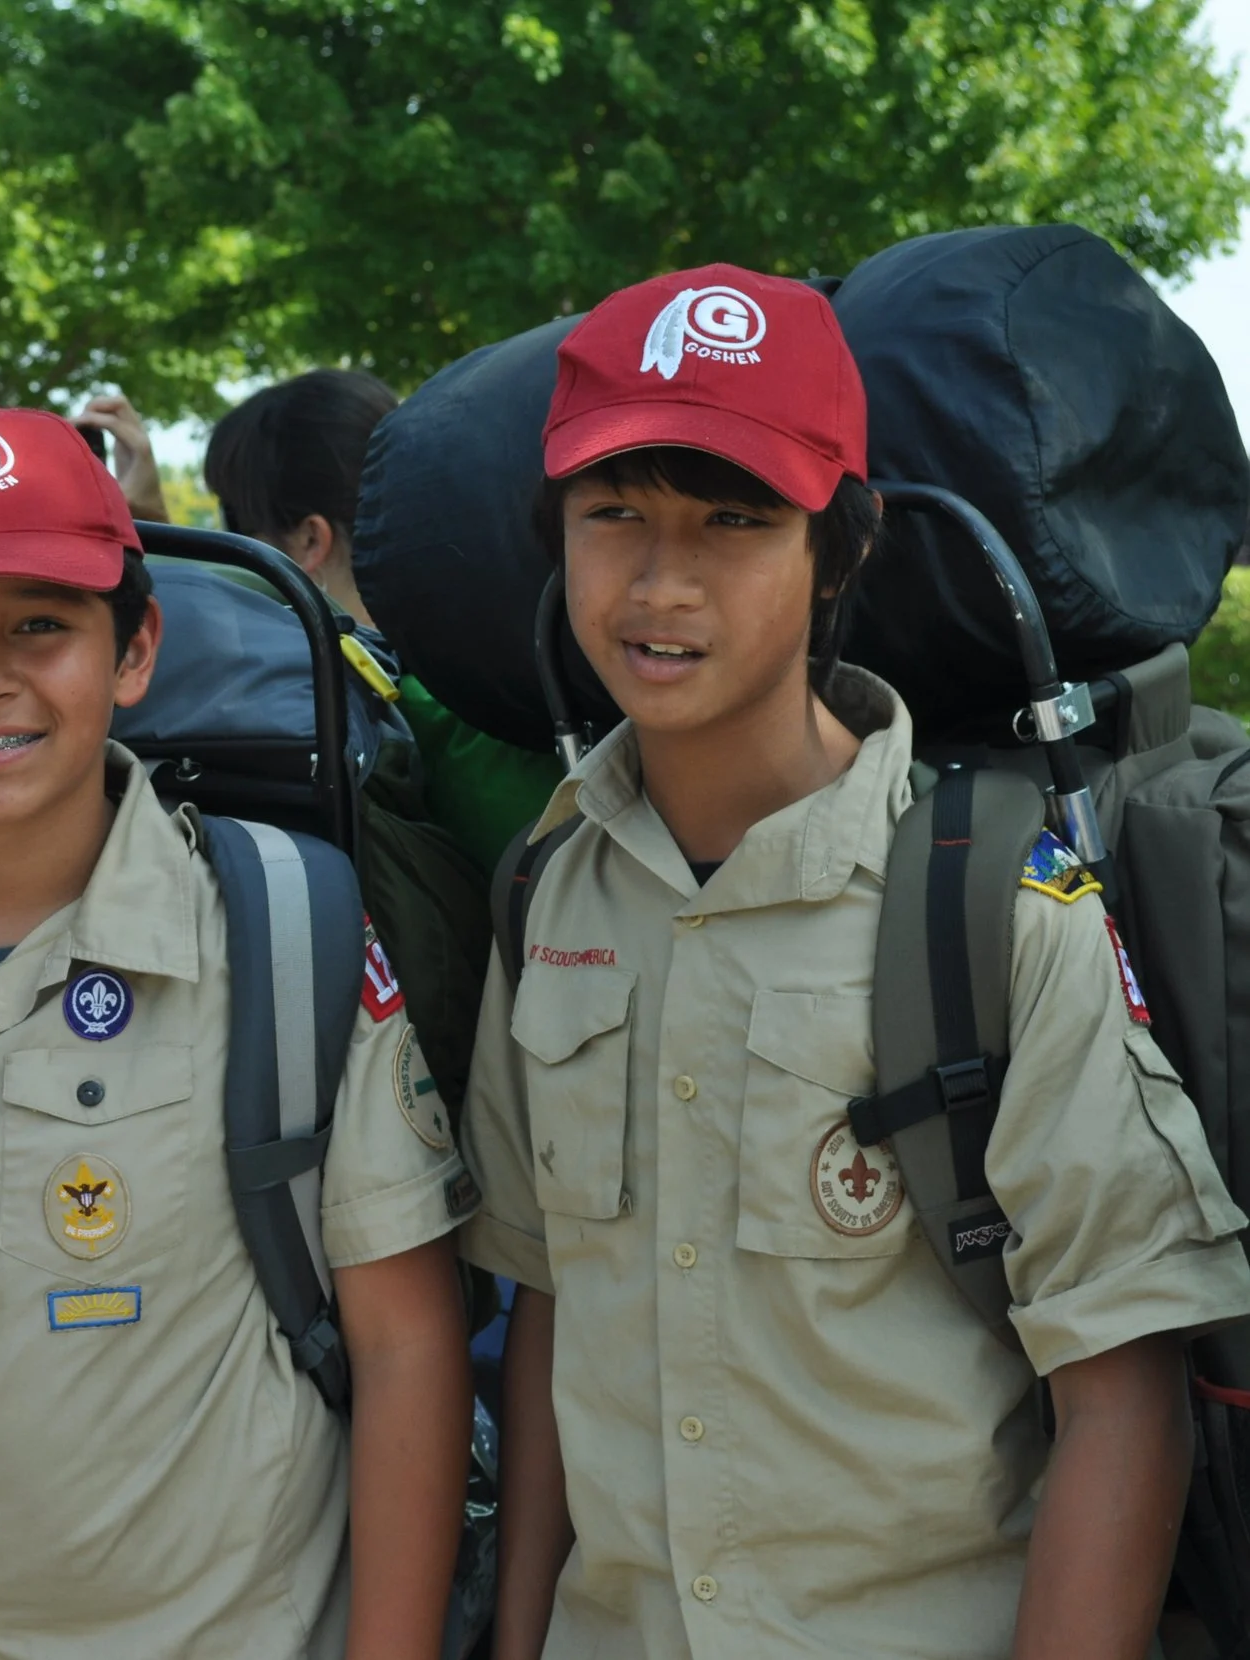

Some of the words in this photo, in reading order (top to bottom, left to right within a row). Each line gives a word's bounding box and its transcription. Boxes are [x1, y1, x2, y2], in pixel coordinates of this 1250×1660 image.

[694, 295, 749, 341] G
[684, 342, 762, 365] GOSHEN
[821, 1181, 835, 1199] BOY
[827, 1199, 859, 1226] SCOUTS
[860, 1212, 872, 1227] OF
